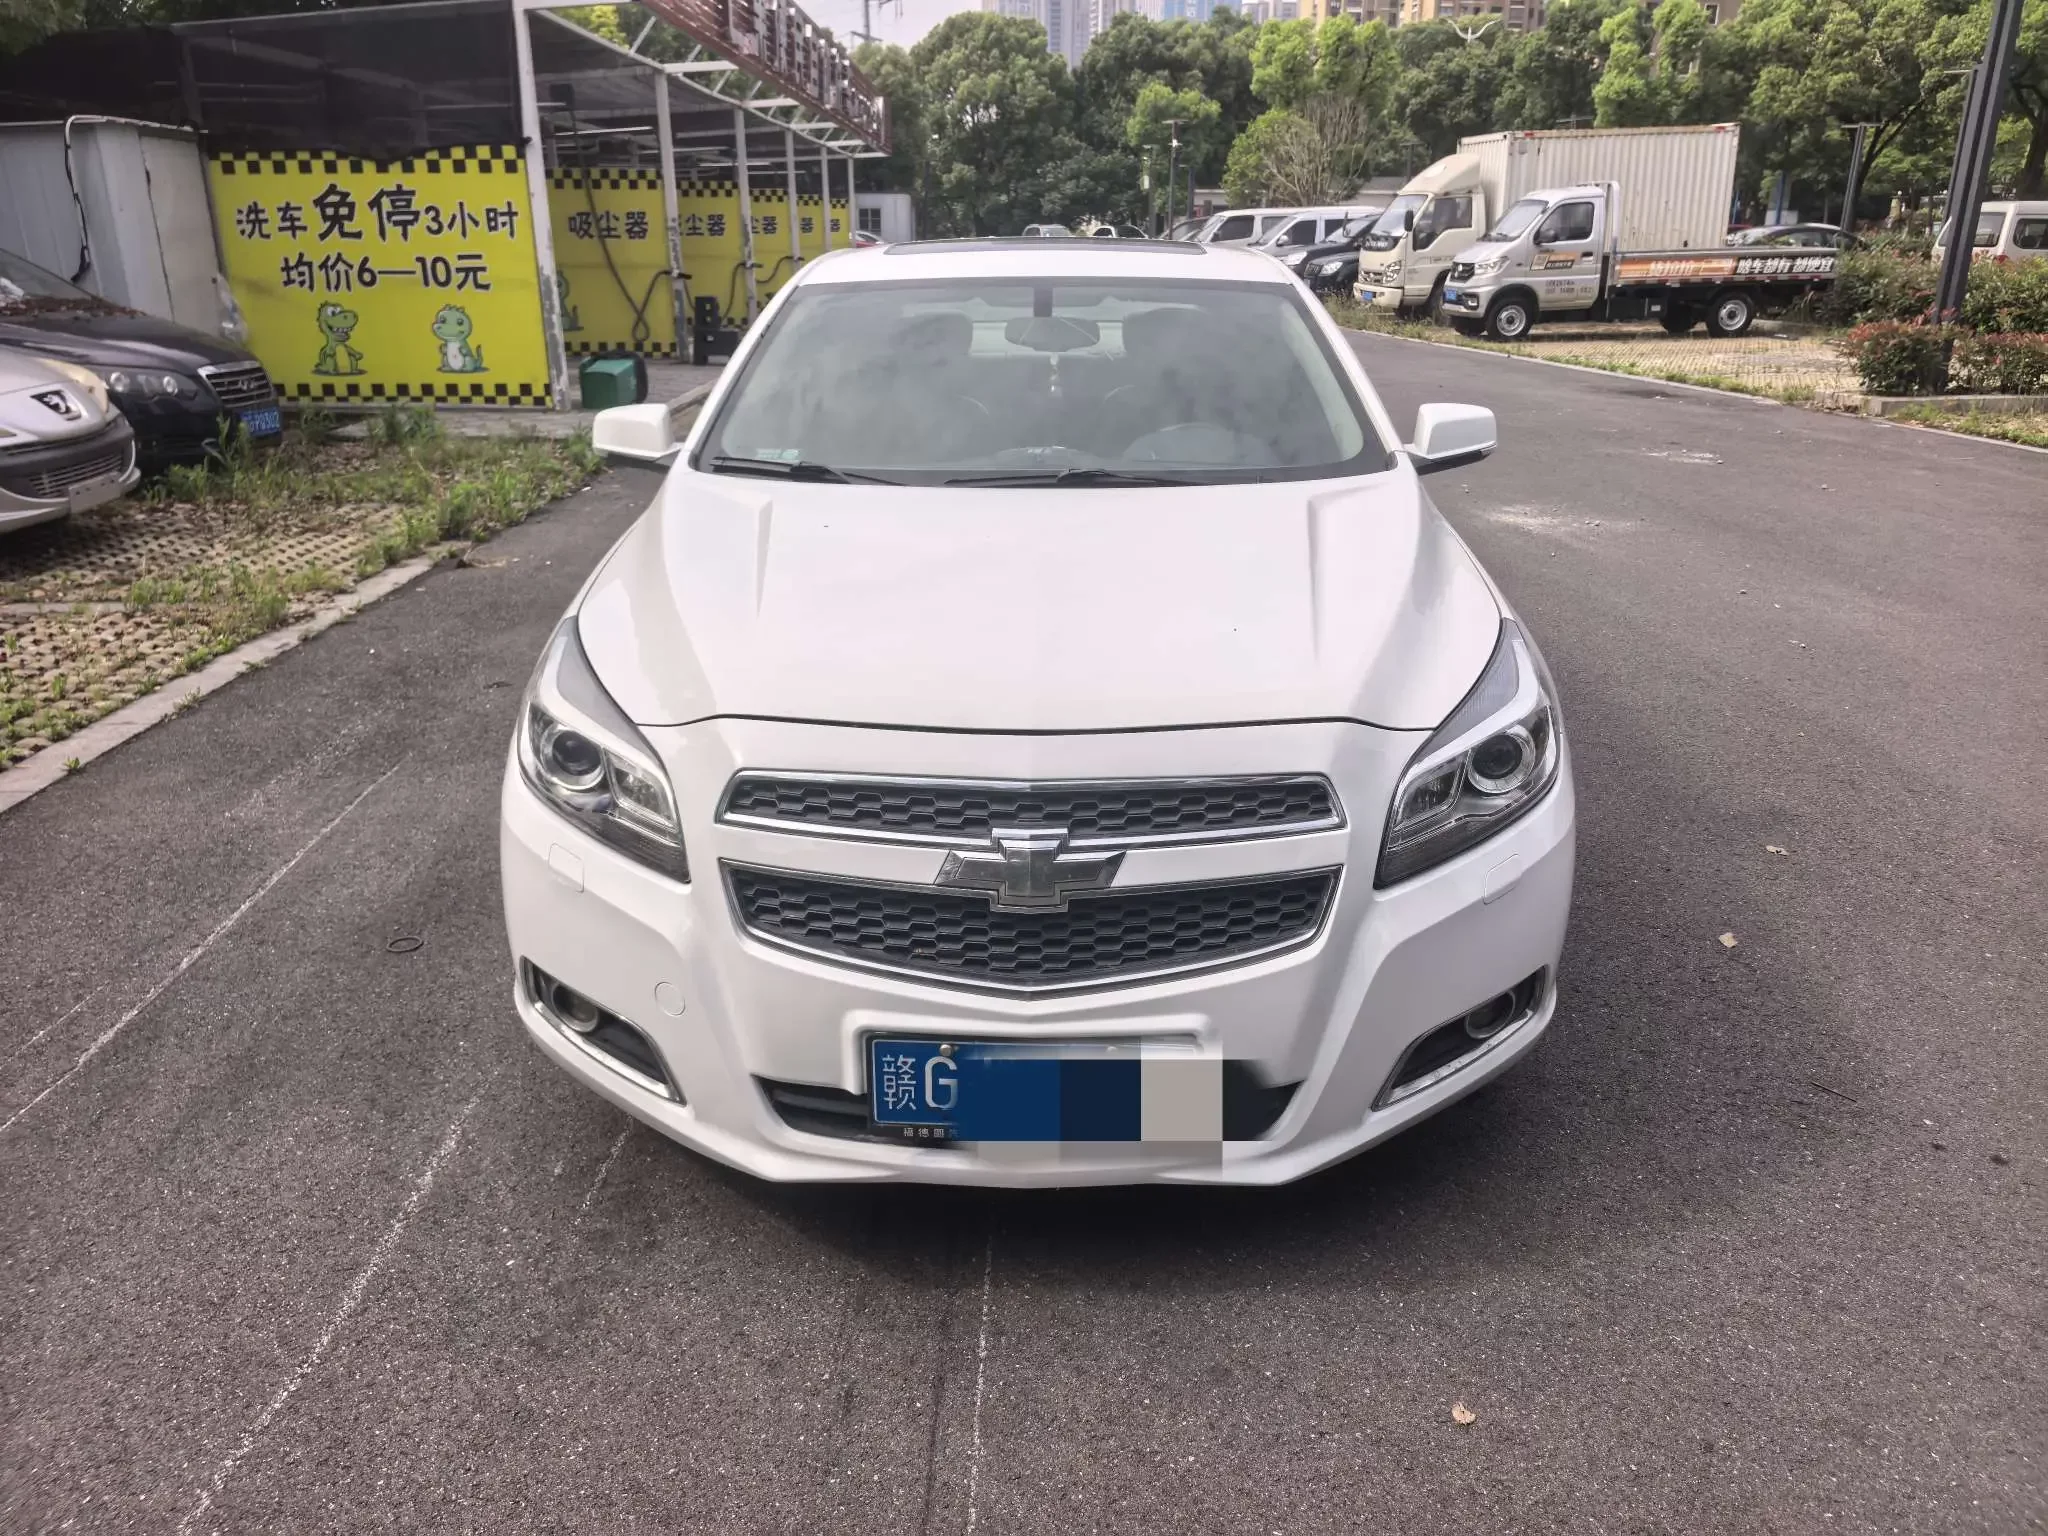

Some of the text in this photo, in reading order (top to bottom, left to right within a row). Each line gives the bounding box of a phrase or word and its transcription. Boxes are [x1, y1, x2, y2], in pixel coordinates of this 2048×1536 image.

[236, 183, 518, 242] 洗车免停3小时
[568, 211, 649, 240] 吸尘器
[678, 213, 725, 236] 尘器
